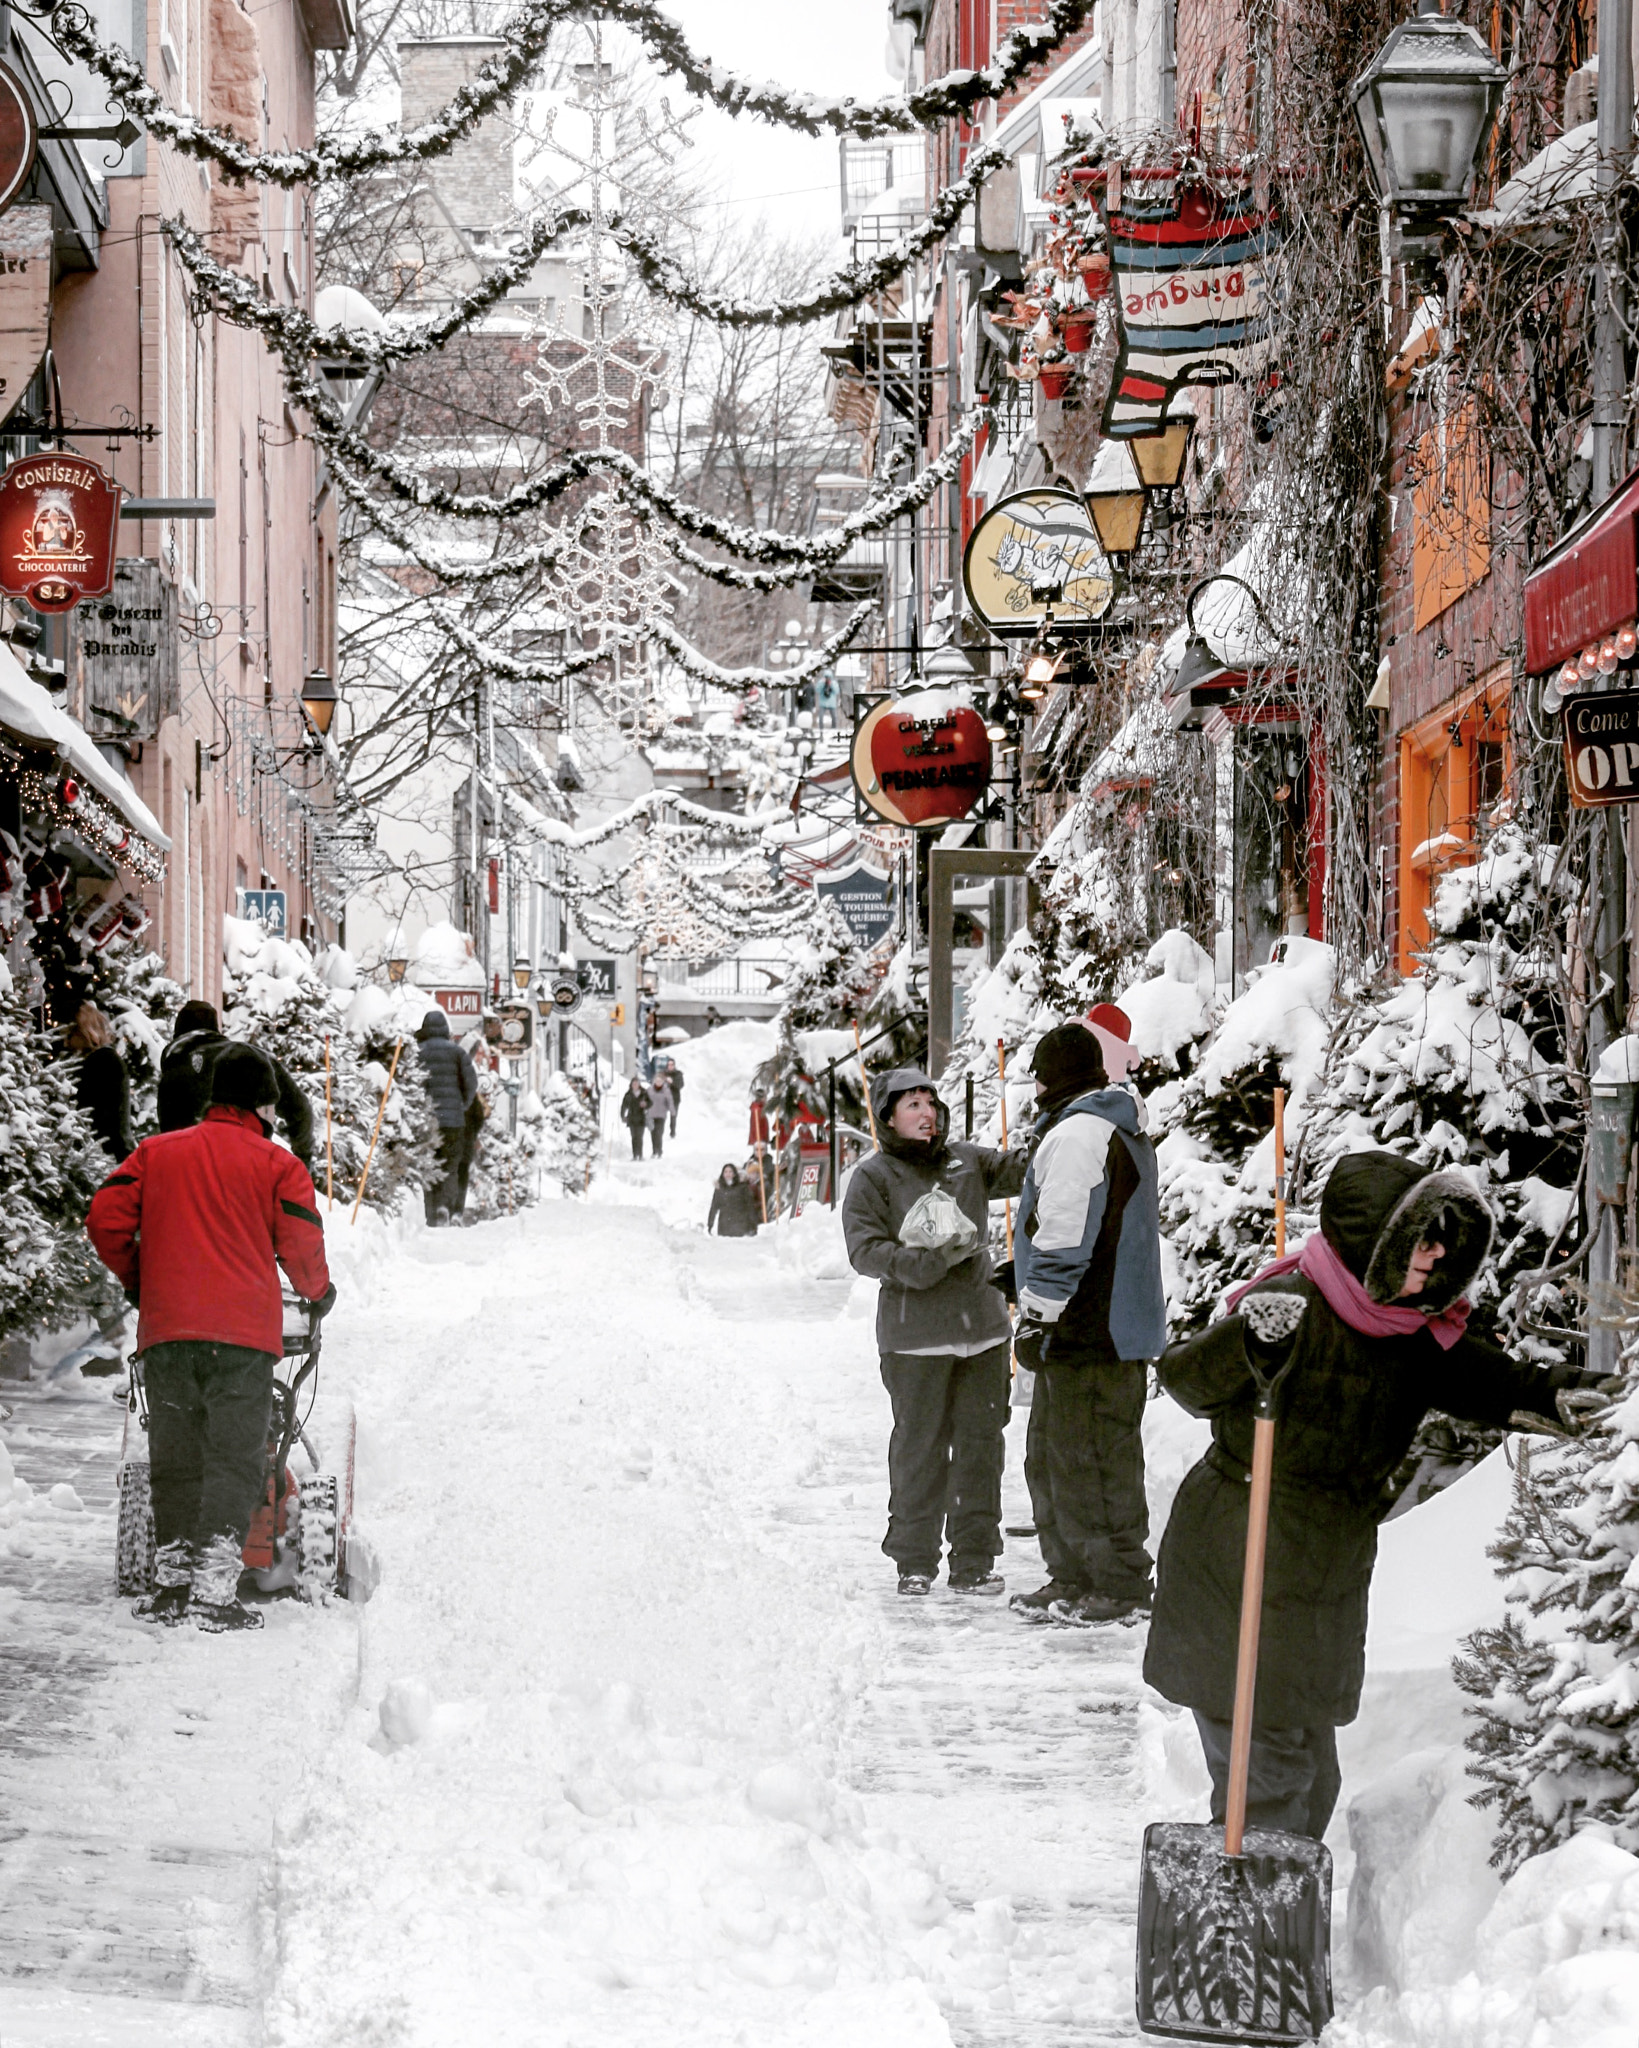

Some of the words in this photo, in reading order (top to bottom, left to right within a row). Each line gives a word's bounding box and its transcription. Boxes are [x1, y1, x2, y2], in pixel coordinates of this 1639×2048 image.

[1126, 271, 1245, 316] Dingue
[18, 562, 88, 573] CHOCOLATERIE
[40, 584, 67, 600] 84
[79, 604, 163, 621] L'Oiseau
[111, 622, 132, 638] du
[84, 640, 157, 659] Paradis
[898, 716, 958, 733] CIDRERIE
[1577, 708, 1630, 734] Come
[860, 833, 885, 849] POUR
[840, 893, 882, 901] GESTION
[850, 911, 889, 923] QUÉBEC
[448, 994, 478, 1012] LAPIN
